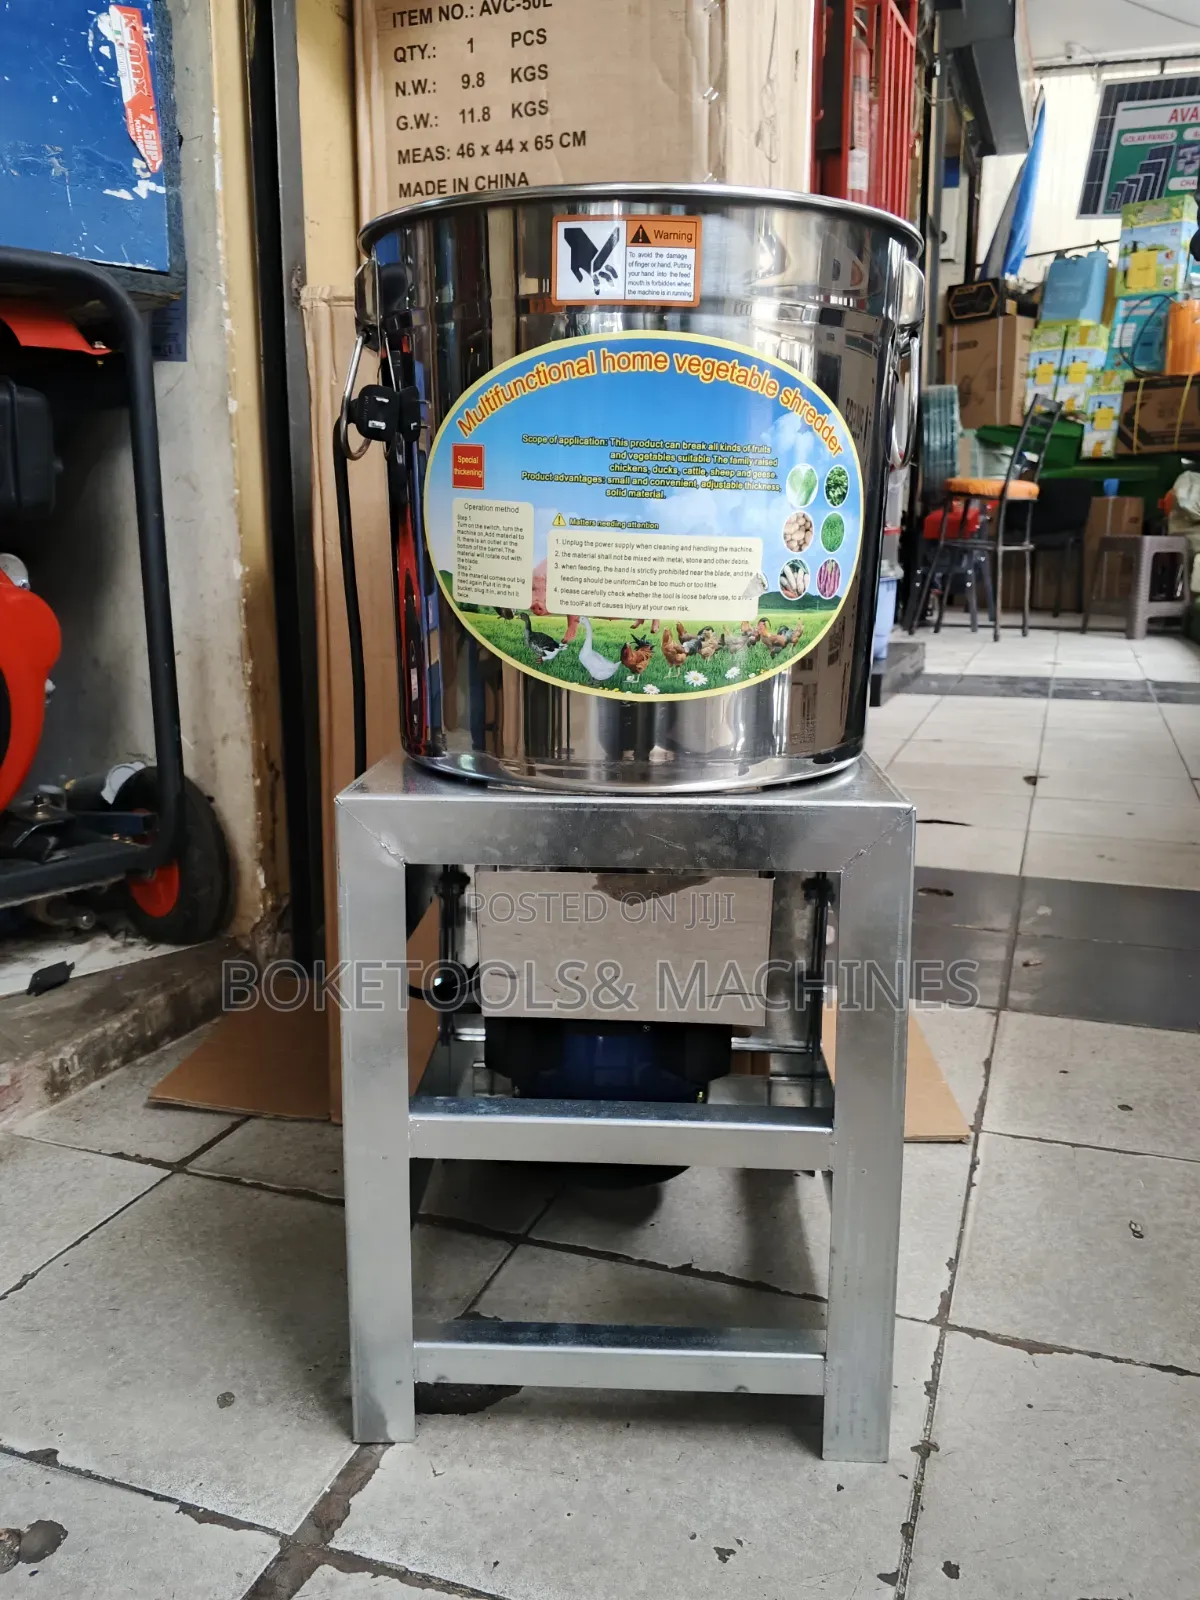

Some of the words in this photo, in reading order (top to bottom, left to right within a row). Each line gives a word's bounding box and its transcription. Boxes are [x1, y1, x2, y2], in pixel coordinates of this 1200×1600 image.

[392, 8, 433, 28] ITEM
[438, 4, 474, 22] NO.:
[393, 44, 436, 62] QTY.:
[466, 37, 474, 54] 1
[511, 28, 548, 48] PCS
[395, 78, 436, 97] N.W.:
[461, 72, 486, 90] 9.8
[510, 64, 548, 84] KGS
[396, 113, 439, 131] G.W.:
[458, 106, 491, 124] 11.8
[511, 100, 549, 118] KGS
[398, 146, 450, 164] MEAS:
[456, 142, 476, 158] 46
[480, 145, 490, 156] x
[494, 138, 514, 154] 44
[519, 140, 528, 152] x
[534, 134, 554, 151] 65
[559, 130, 586, 148] CM
[398, 178, 447, 198] MADE
[452, 176, 468, 194] IN
[475, 172, 529, 191] CHINA
[654, 230, 692, 243] Warning
[673, 262, 691, 270] Putting
[457, 351, 596, 437] Multifunctional
[602, 348, 668, 372] home
[674, 354, 779, 398] vegetable
[780, 387, 844, 456] shredder
[522, 434, 548, 445] Scope
[549, 435, 558, 444] of
[559, 436, 608, 446] application:
[610, 437, 628, 447] This
[630, 439, 663, 448] product
[682, 441, 706, 450] break
[708, 442, 718, 451] all
[720, 442, 741, 452] kinds
[742, 444, 751, 452] of
[751, 444, 771, 454] fruits
[457, 456, 479, 464] Special
[610, 451, 627, 460] and
[628, 452, 675, 461] vegetables
[678, 454, 711, 463] suitable
[713, 454, 728, 464] The
[730, 456, 753, 466] family
[754, 458, 778, 466] raised
[454, 468, 483, 478] thickening
[609, 464, 650, 474] chickens,
[652, 464, 680, 475] ducks,
[682, 466, 708, 477] cattle,
[710, 468, 735, 479] sheep
[736, 469, 751, 477] and
[521, 472, 553, 481] Product
[554, 474, 606, 485] advantages:
[607, 476, 630, 484] small
[632, 476, 648, 485] and
[650, 479, 699, 489] convenient,
[701, 480, 743, 490] adjustable
[744, 482, 782, 492] thickness,
[606, 488, 626, 496] solid
[628, 490, 666, 499] material.
[464, 502, 493, 512] Operation
[569, 518, 596, 526] Matters
[597, 520, 626, 528] needing
[562, 539, 583, 547] Unplug
[692, 545, 718, 553] handling
[578, 564, 602, 572] feeding,
[560, 576, 583, 584] feeding
